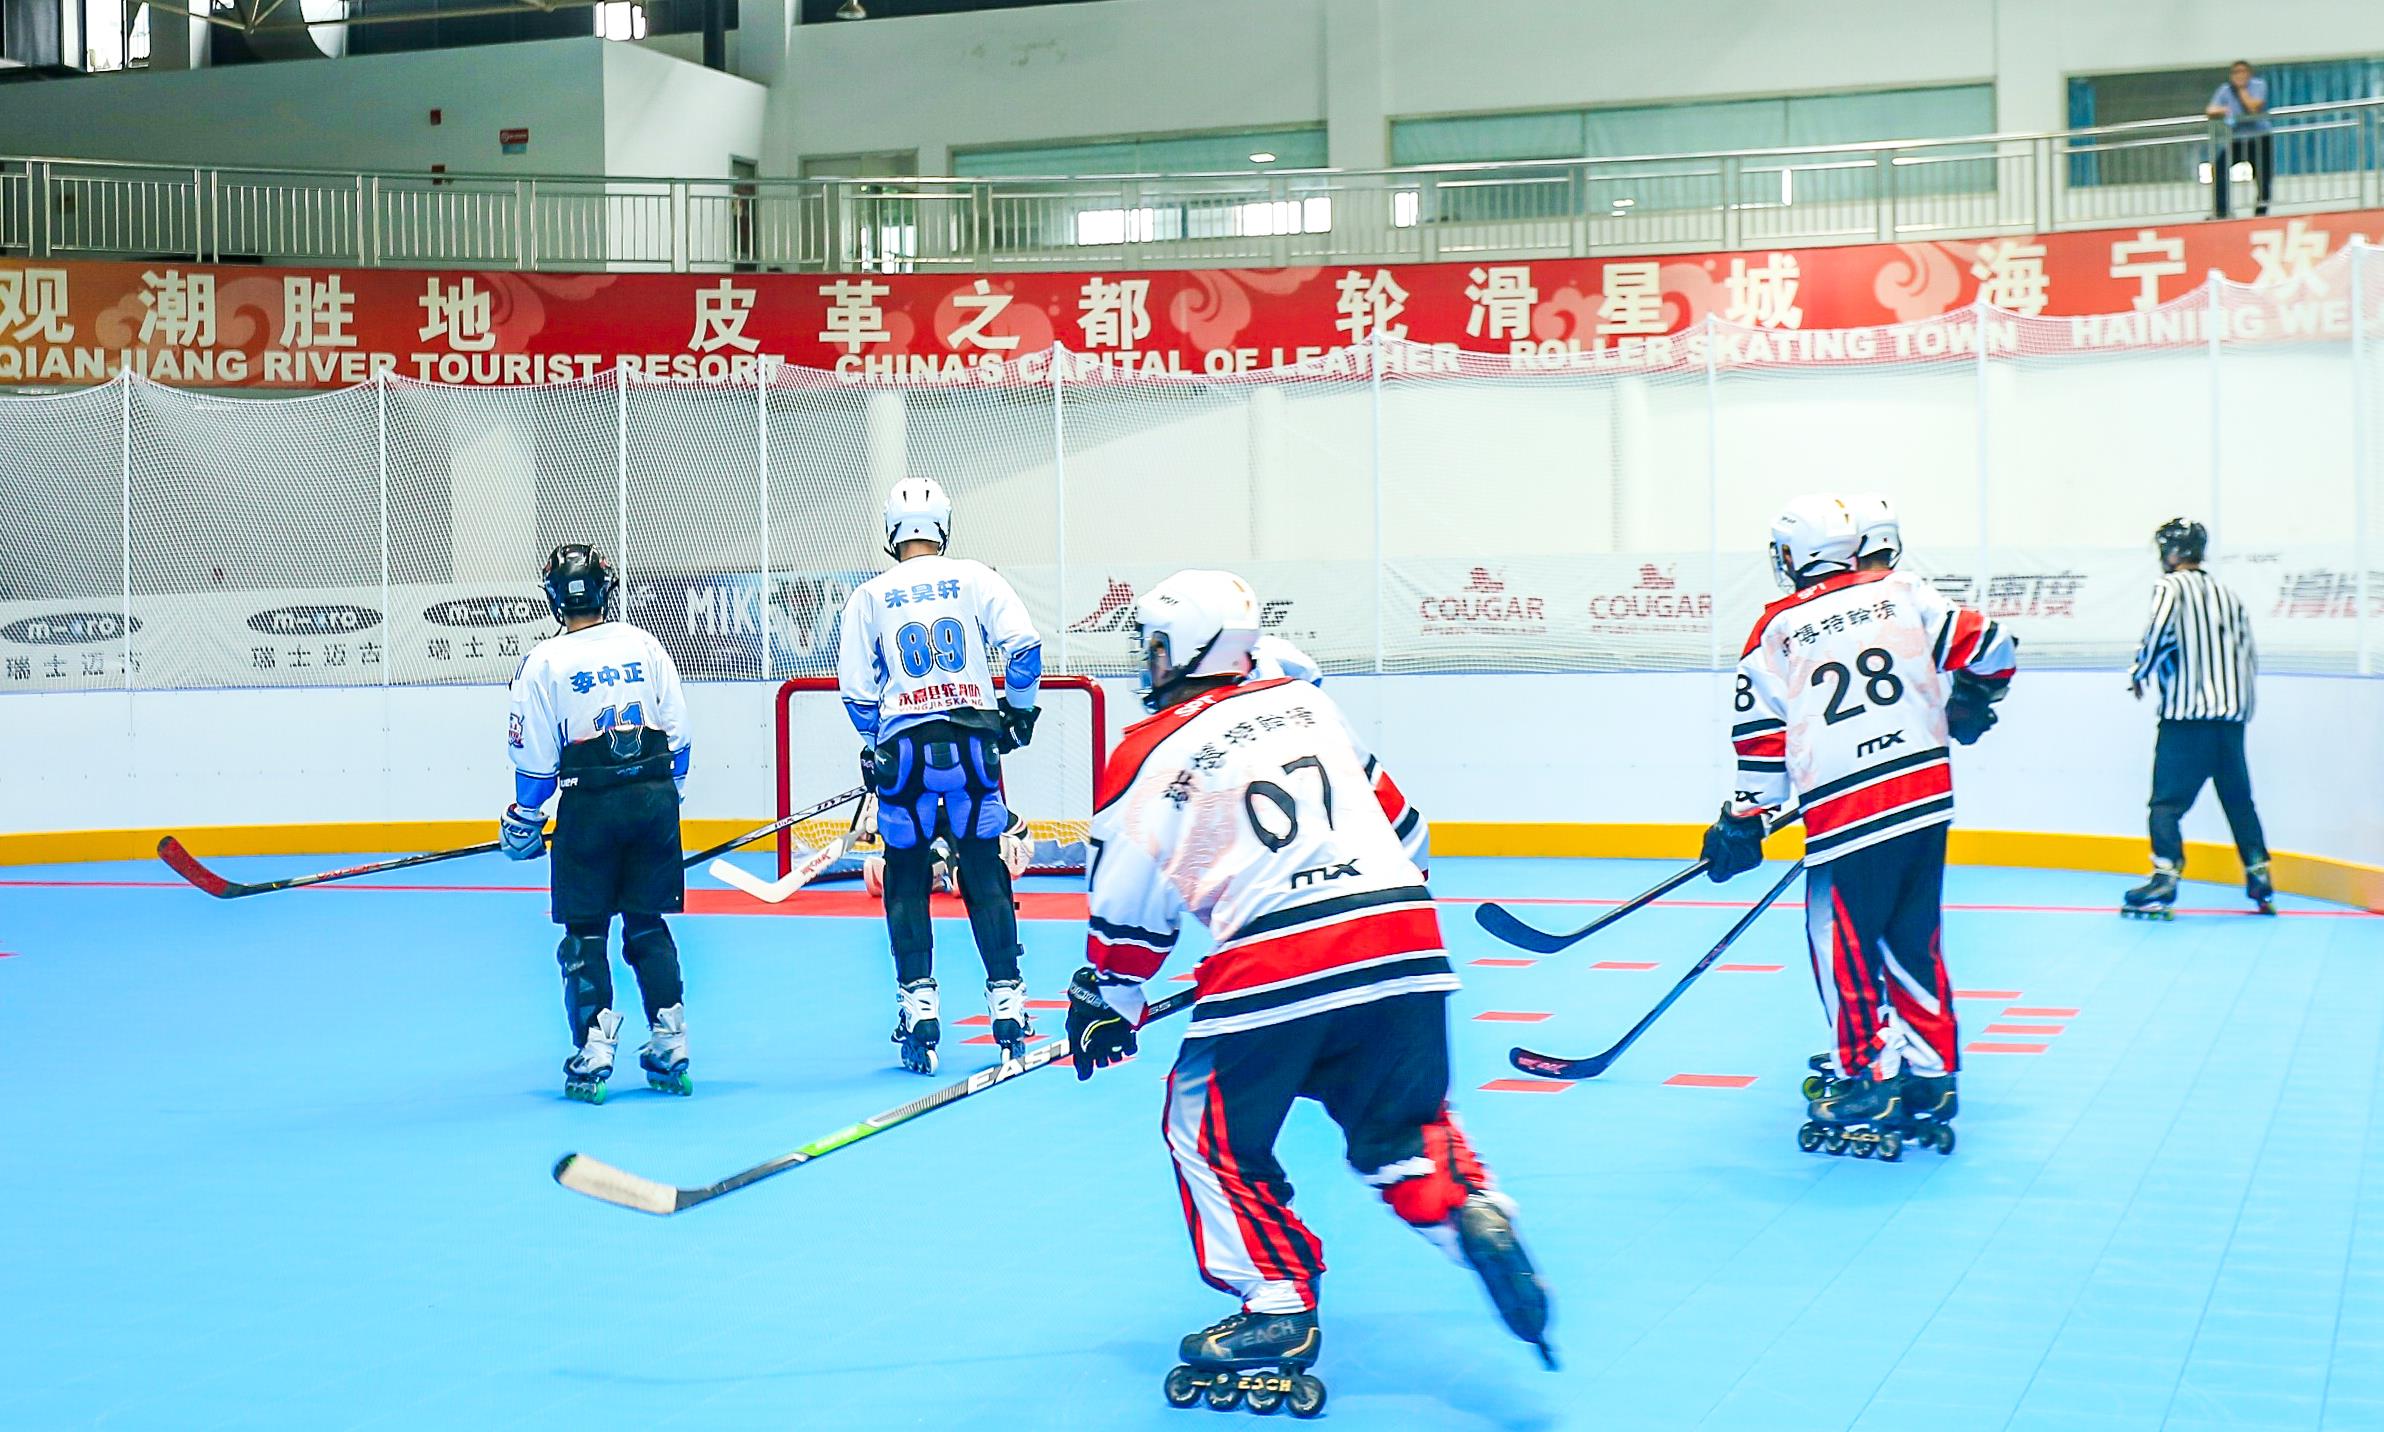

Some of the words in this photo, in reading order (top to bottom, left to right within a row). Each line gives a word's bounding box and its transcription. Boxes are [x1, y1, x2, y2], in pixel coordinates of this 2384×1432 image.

[687, 276, 1152, 353] 皮革之都
[1335, 252, 1803, 342] 轮滑星城
[0, 347, 248, 381] QIANJIANG
[264, 351, 397, 383] RIVER
[411, 352, 602, 385] TOURIST
[616, 354, 785, 385] RESORT
[835, 352, 1004, 383] CHINA'S
[1018, 350, 1193, 381] CAPITAL
[1204, 348, 1258, 377] OF
[1272, 342, 1462, 376] LEATHER
[1511, 336, 1673, 370] ROLLER
[1686, 329, 1878, 364] SKATING
[1895, 322, 2018, 356] TOWN
[2071, 304, 2265, 346] HAINING
[1420, 596, 1545, 622] COUGAR
[1589, 594, 1712, 621] COUGAR
[896, 617, 966, 678] 89
[1811, 647, 1904, 726] 28
[1246, 755, 1334, 853] 07
[1242, 1319, 1296, 1346] EACH
[1237, 1377, 1293, 1393] EACH
